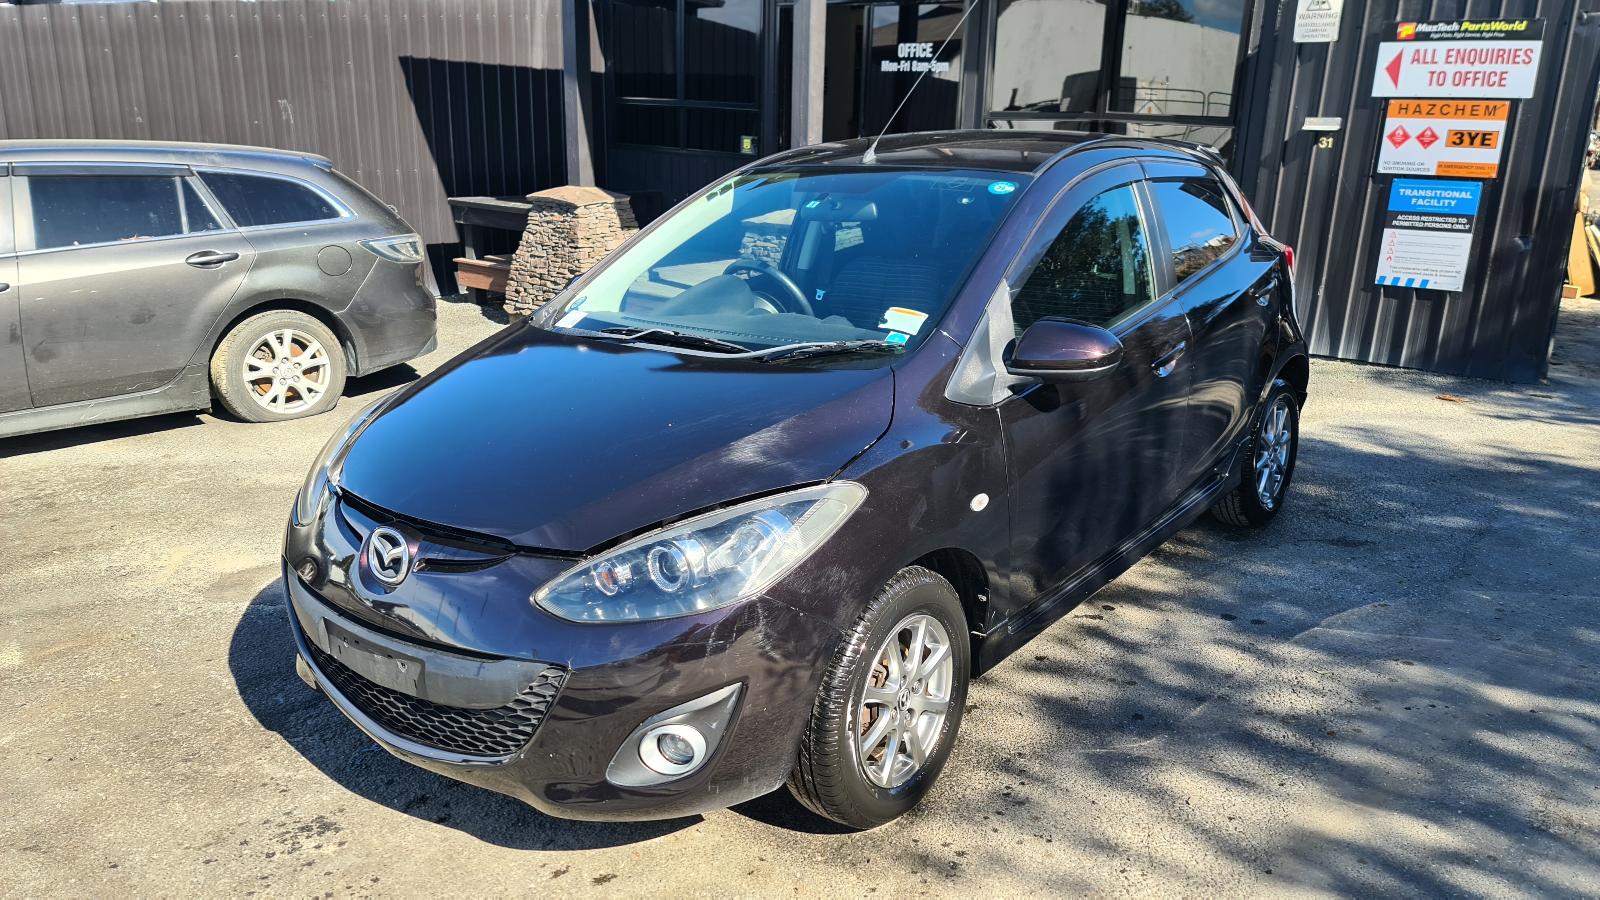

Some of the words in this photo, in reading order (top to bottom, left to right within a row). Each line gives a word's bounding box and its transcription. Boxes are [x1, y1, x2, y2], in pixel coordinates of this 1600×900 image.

[1416, 21, 1460, 32] MaxTech
[1460, 20, 1528, 32] PartsWorld
[897, 42, 934, 58] OFFICE
[1410, 48, 1439, 65] ALL
[1444, 48, 1534, 66] ENQUIRIES
[881, 60, 911, 72] Mon-Fri
[911, 60, 949, 74] 8am-5pm
[1428, 70, 1447, 87] TO
[1452, 70, 1509, 88] OFFICE
[1397, 103, 1497, 116] HAZCHEM
[1318, 137, 1333, 148] 31
[1451, 131, 1493, 147] 3YE
[1399, 188, 1473, 199] TRANSITIONAL
[1411, 198, 1457, 207] FACILITY
[1420, 215, 1457, 223] RESTRICTED
[1424, 221, 1452, 229] PERSONS
